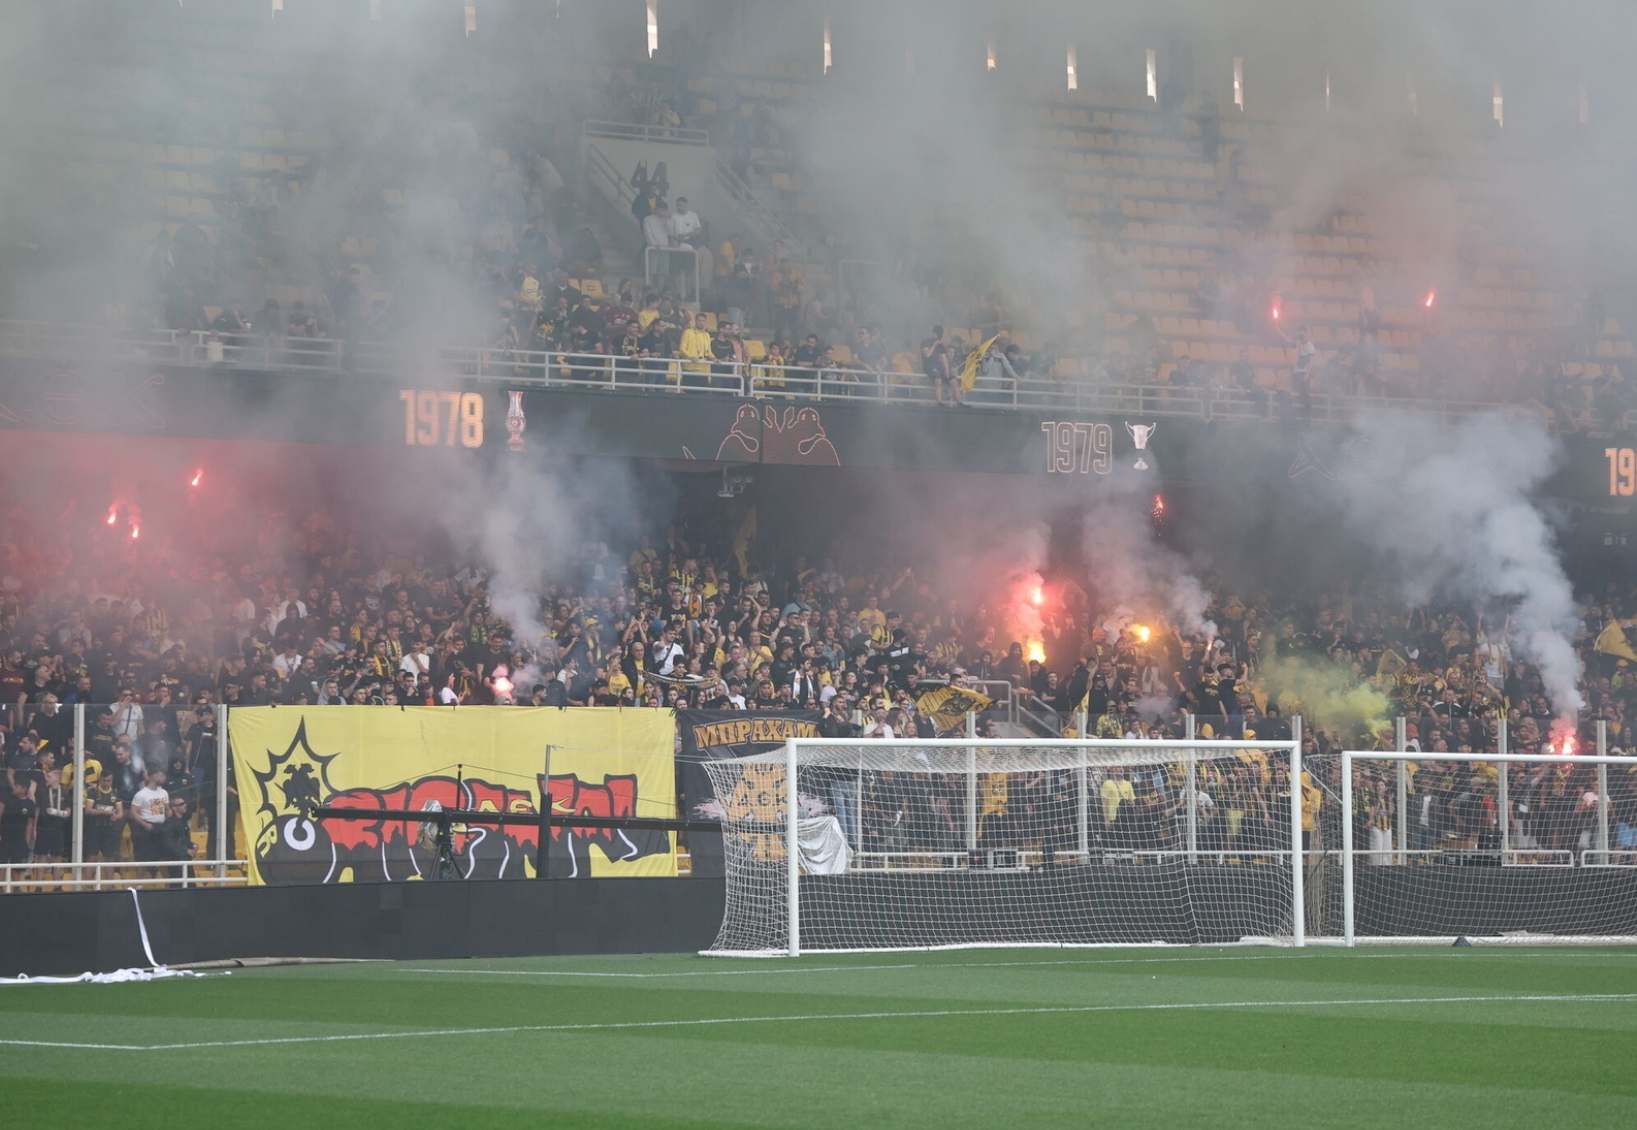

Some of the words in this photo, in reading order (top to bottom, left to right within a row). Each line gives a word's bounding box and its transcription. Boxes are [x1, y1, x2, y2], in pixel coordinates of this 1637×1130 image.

[631, 160, 670, 197] 44
[399, 389, 484, 448] 1978
[1041, 421, 1113, 475] 1979
[1604, 447, 1637, 496] 19
